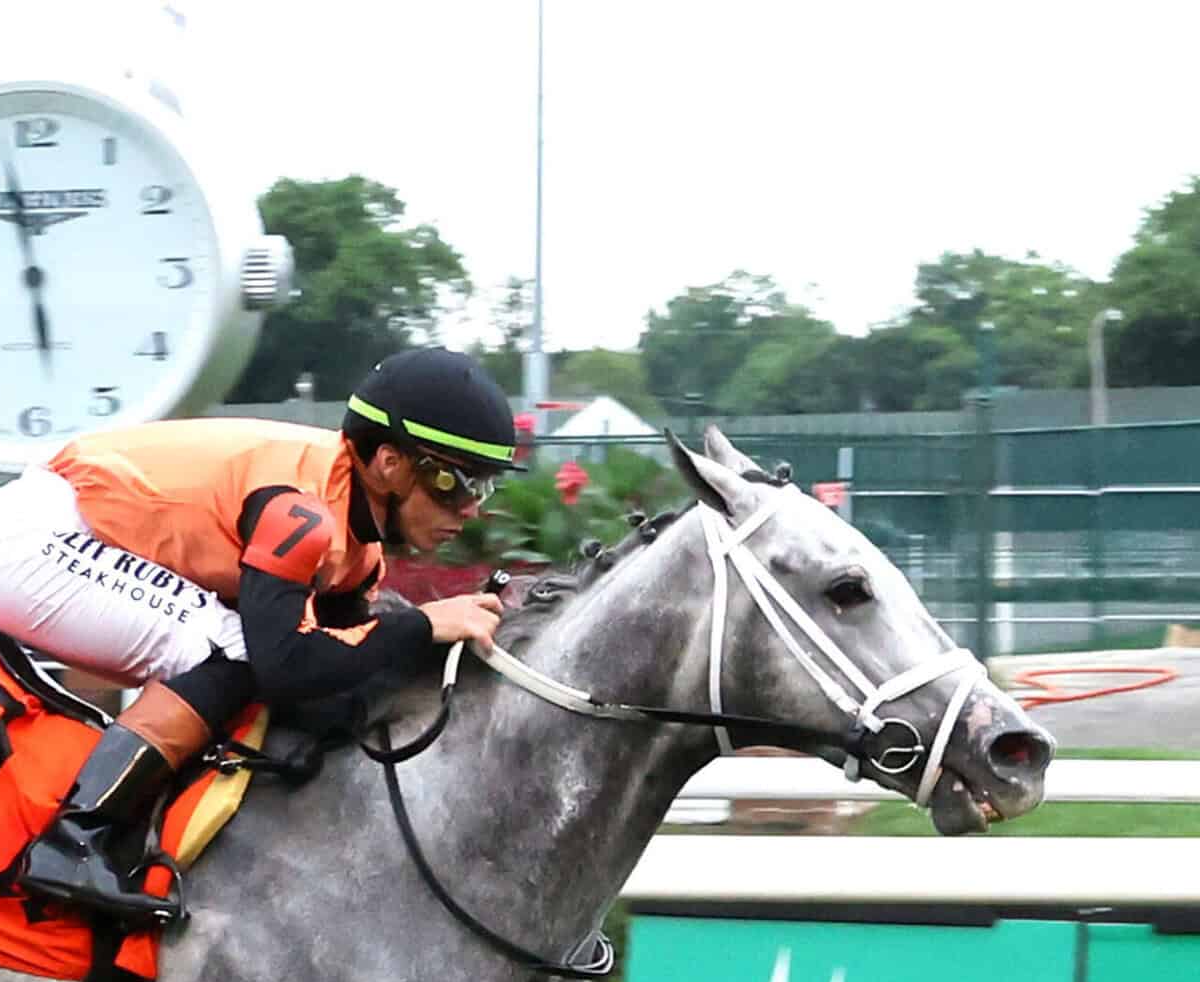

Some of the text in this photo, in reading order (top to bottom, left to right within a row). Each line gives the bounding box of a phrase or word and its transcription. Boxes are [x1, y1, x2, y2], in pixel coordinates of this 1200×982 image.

[14, 117, 60, 147] 12
[102, 136, 118, 165] 1
[140, 184, 174, 216] 2
[158, 257, 194, 289] 3
[133, 331, 169, 361] 4
[91, 385, 121, 417] 5
[18, 406, 52, 437] 6
[273, 504, 322, 558] 7
[41, 543, 191, 624] STEAKHOUSE
